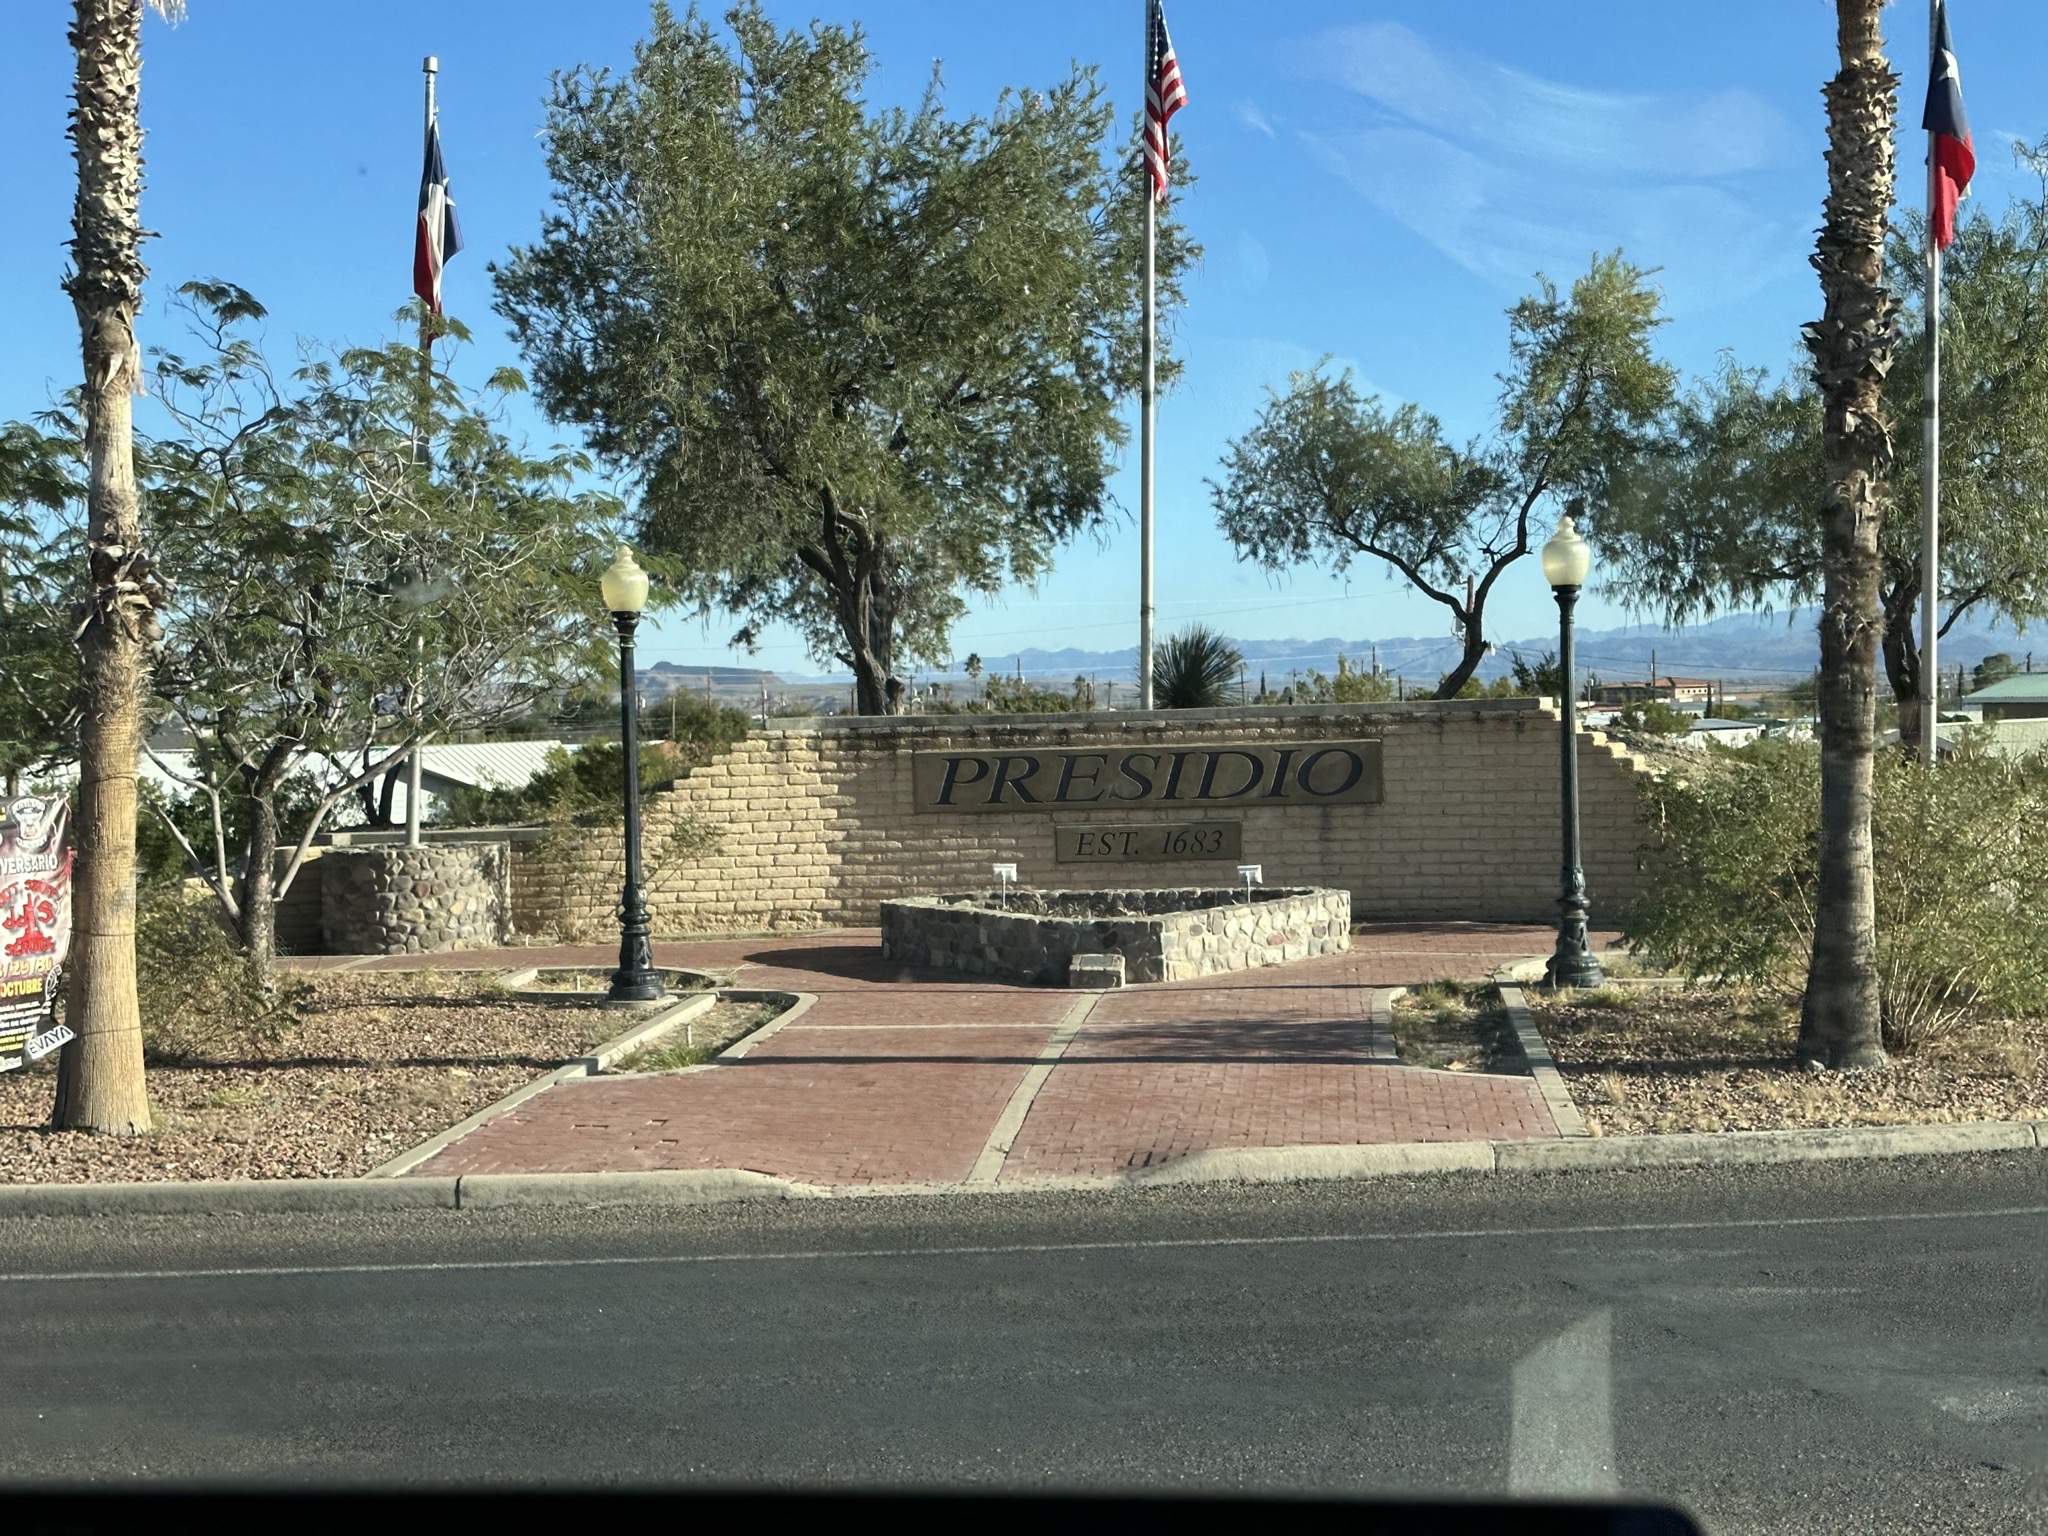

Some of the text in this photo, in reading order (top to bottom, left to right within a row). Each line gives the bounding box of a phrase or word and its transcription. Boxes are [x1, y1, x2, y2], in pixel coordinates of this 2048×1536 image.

[929, 748, 1364, 806] PRESIDIO
[1075, 830, 1223, 856] EST. 1683
[0, 978, 43, 998] OCTUBRE
